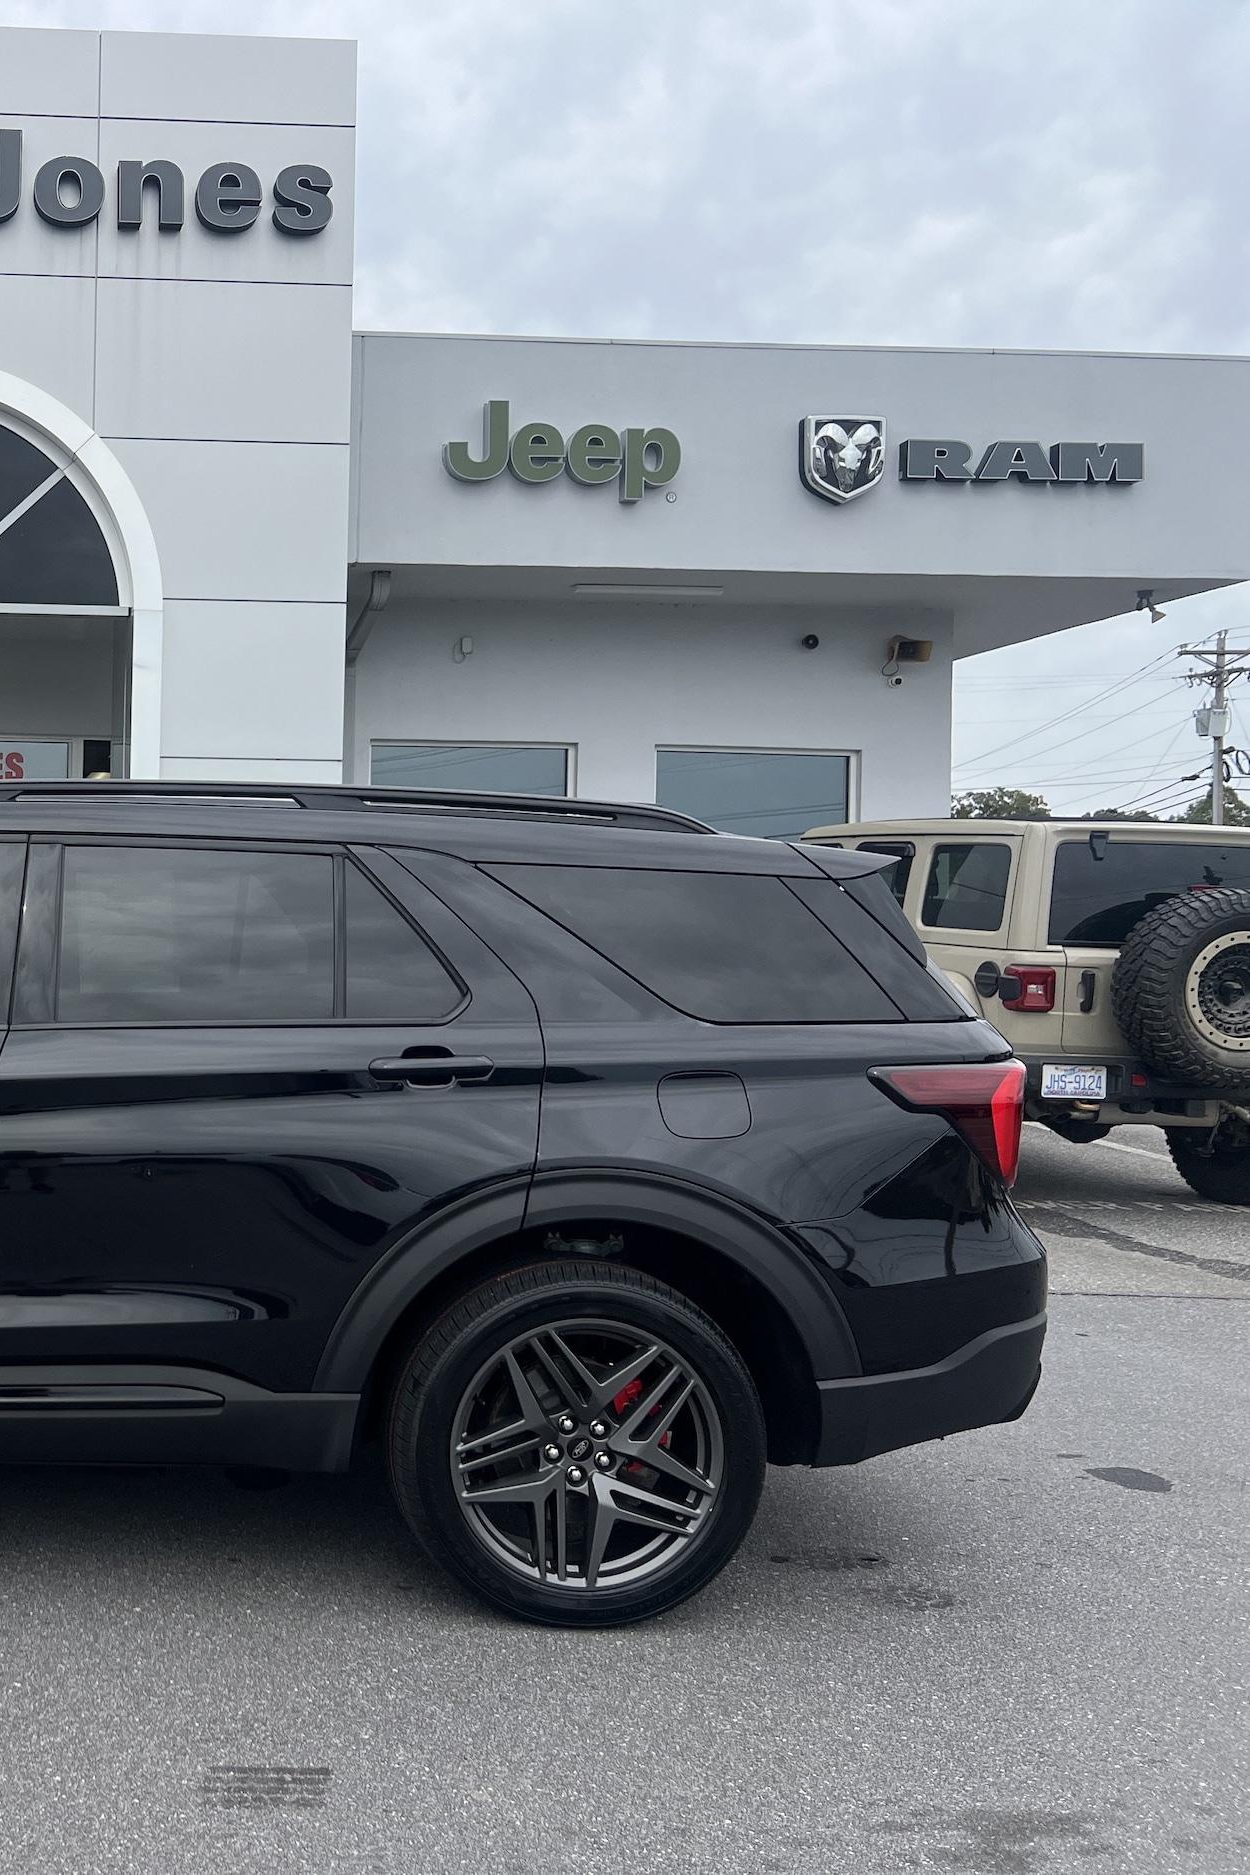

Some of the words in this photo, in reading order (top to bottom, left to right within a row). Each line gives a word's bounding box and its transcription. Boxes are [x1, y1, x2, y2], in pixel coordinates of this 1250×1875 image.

[442, 400, 681, 503] Jeep
[899, 438, 1146, 485] RAM
[1045, 1073, 1102, 1091] JHS-9124
